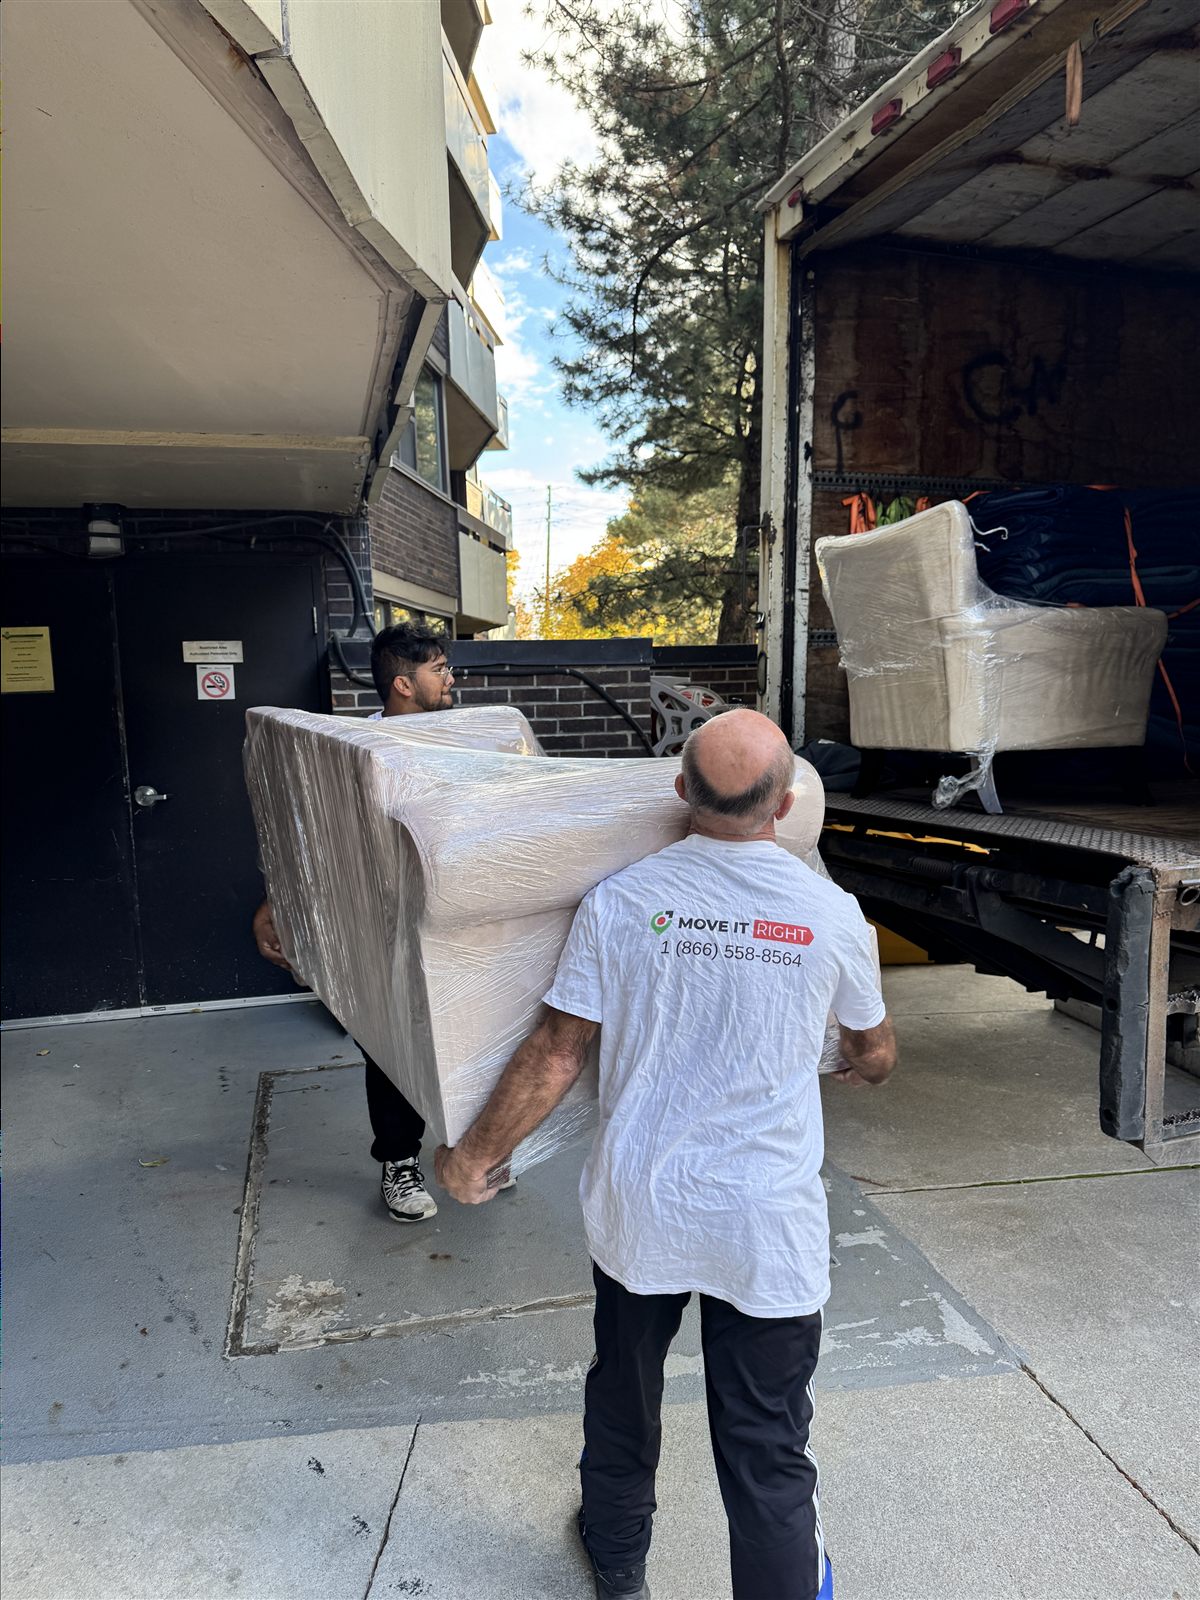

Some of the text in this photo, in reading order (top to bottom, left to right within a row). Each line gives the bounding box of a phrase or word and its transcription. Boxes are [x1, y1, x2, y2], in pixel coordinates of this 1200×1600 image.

[678, 916, 808, 942] MOVE IT RIGHT
[660, 940, 802, 968] 1 (866) 558-8564
